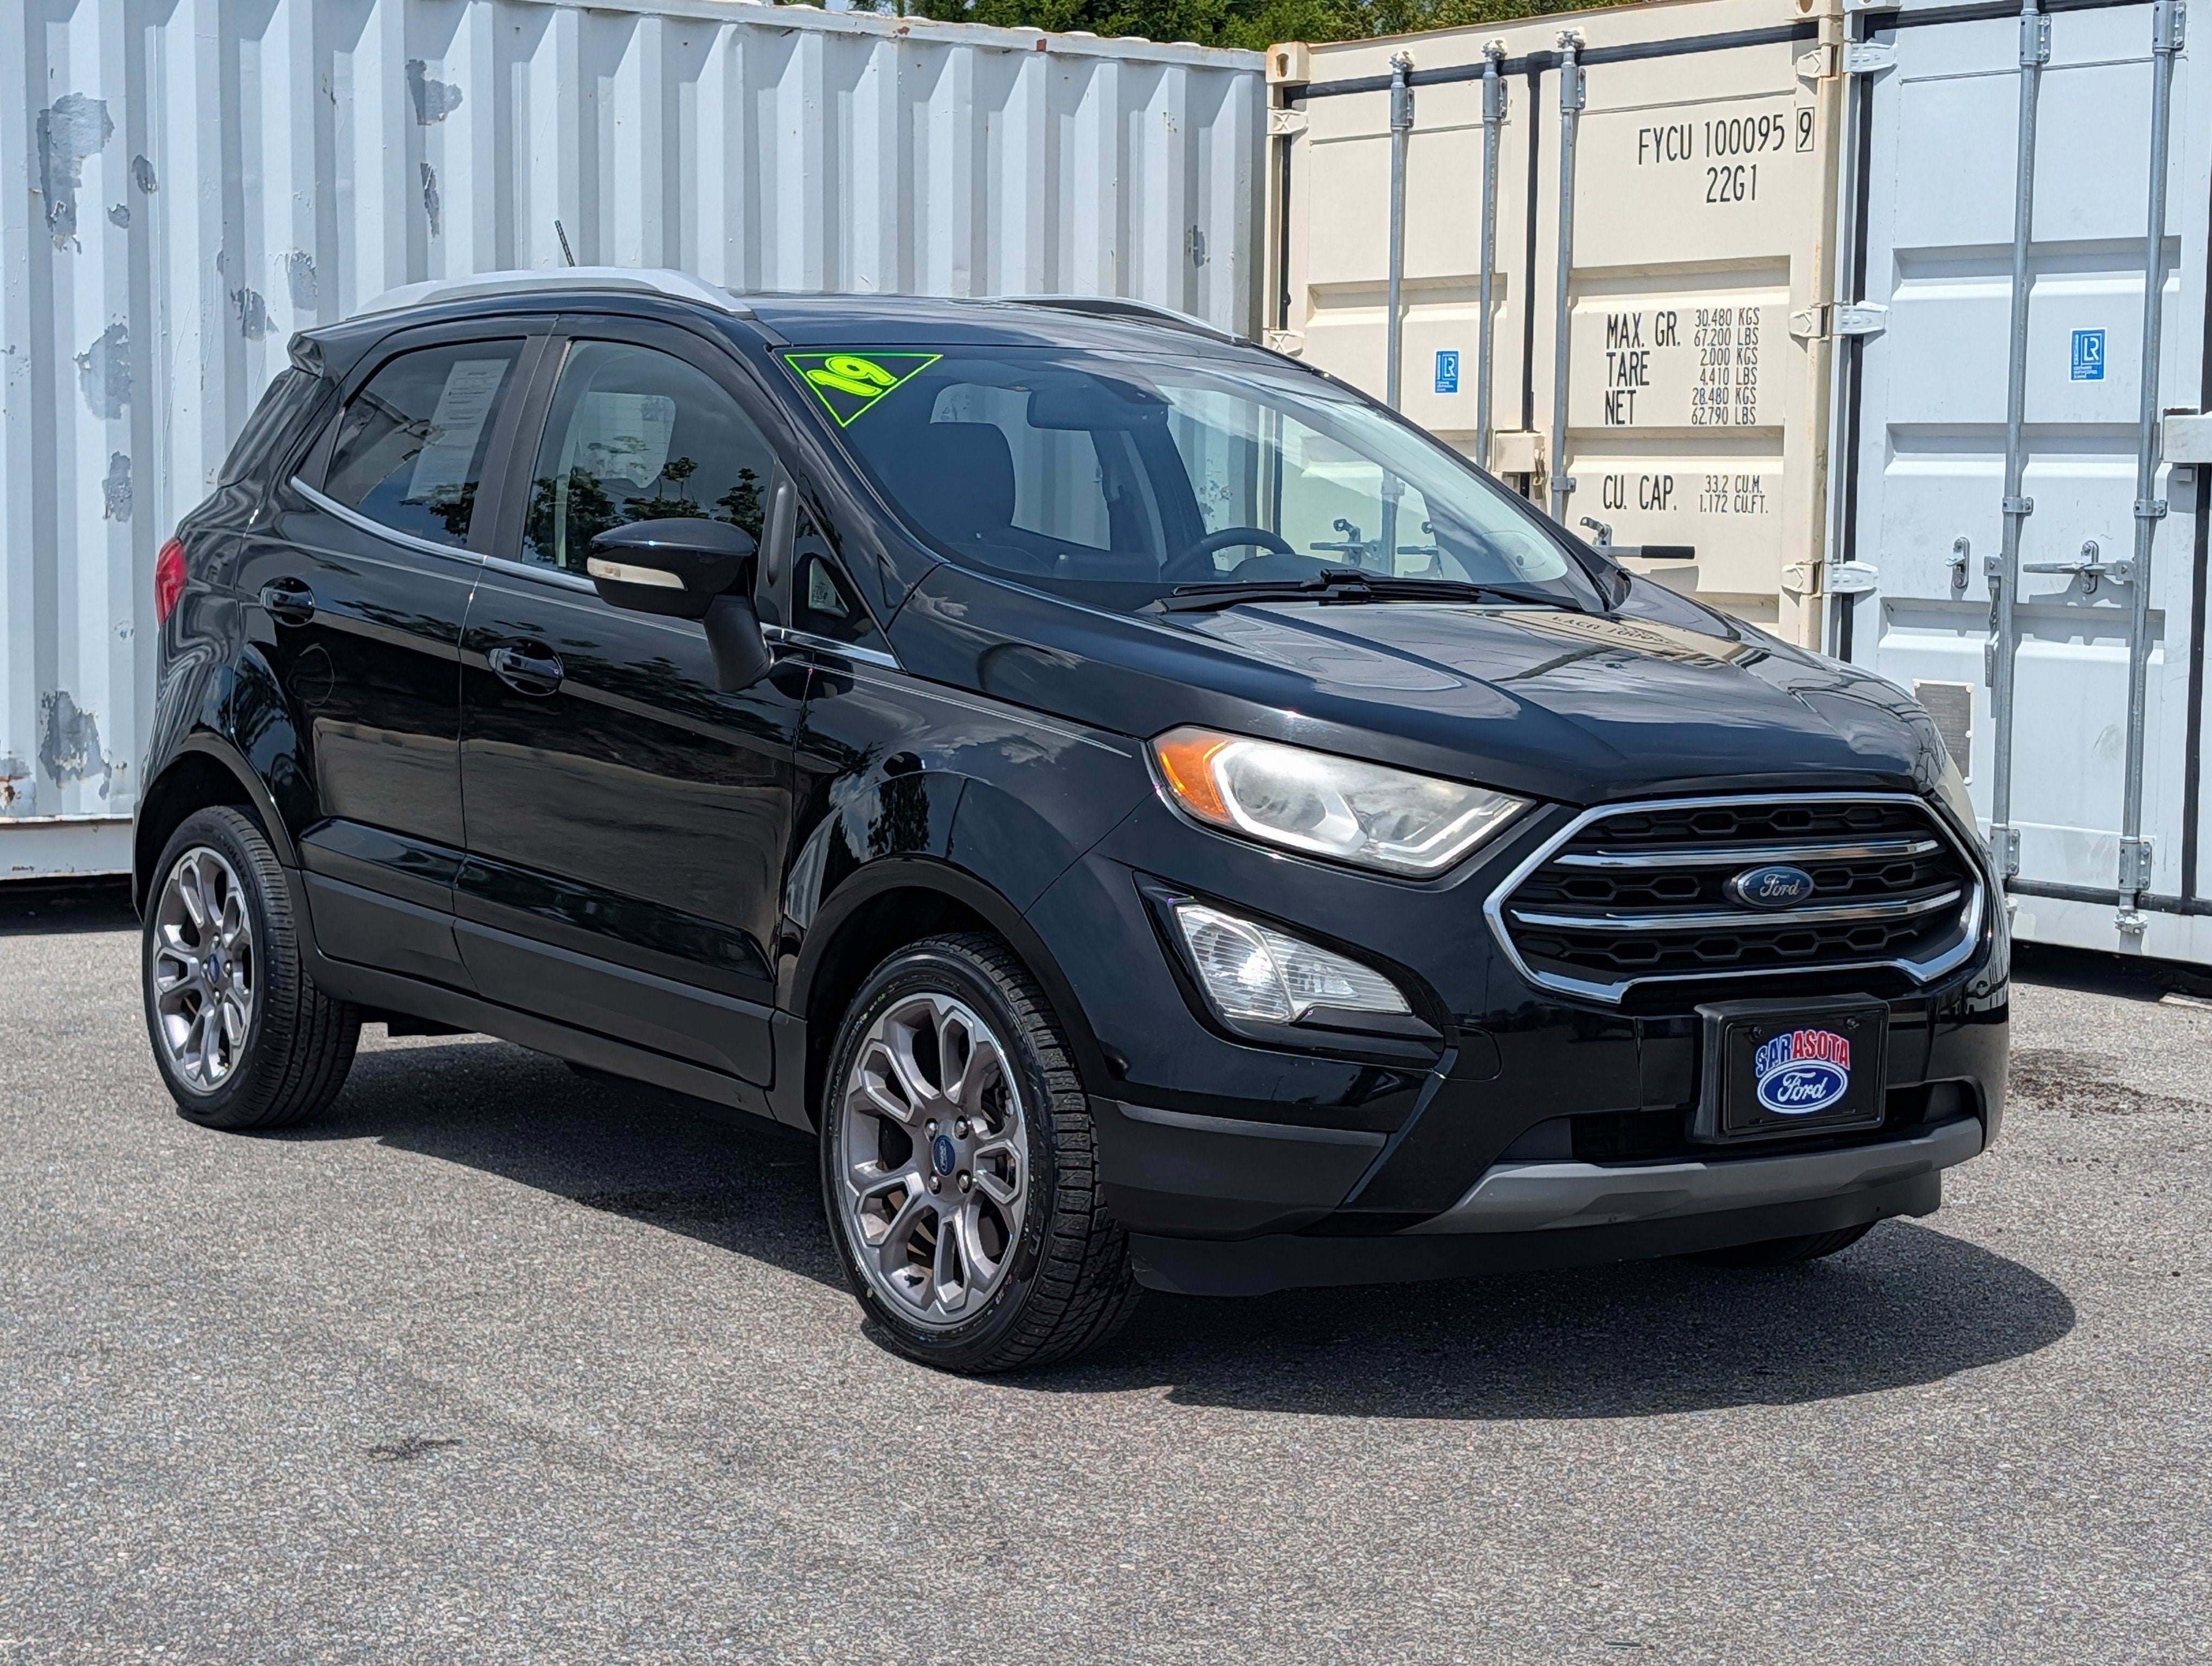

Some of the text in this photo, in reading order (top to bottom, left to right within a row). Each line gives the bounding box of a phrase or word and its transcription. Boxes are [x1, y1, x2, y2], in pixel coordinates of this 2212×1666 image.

[1638, 111, 1812, 165] FYCU 100095 9
[1706, 163, 1757, 203] 22G1
[1606, 311, 1681, 349] MAX. GR.
[1694, 307, 1760, 328] 30.480 KGS
[1694, 326, 1759, 347] 67.200 LBS
[1606, 351, 1650, 387] TARE
[1736, 347, 1758, 366] KGS
[806, 356, 898, 397] 19
[1700, 366, 1758, 386] 4.410 LBS
[1605, 389, 1637, 425] NET
[1692, 386, 1757, 406] 28.480 KGS
[1735, 406, 1756, 425] LBS
[1603, 475, 1677, 511] CU. CAP.
[1705, 475, 1729, 494] 33.2
[1699, 494, 1728, 513] 1.172
[1759, 874, 1801, 897] Ford
[1756, 1029, 1851, 1079] SARASOTA
[1777, 1071, 1829, 1103] Ford
